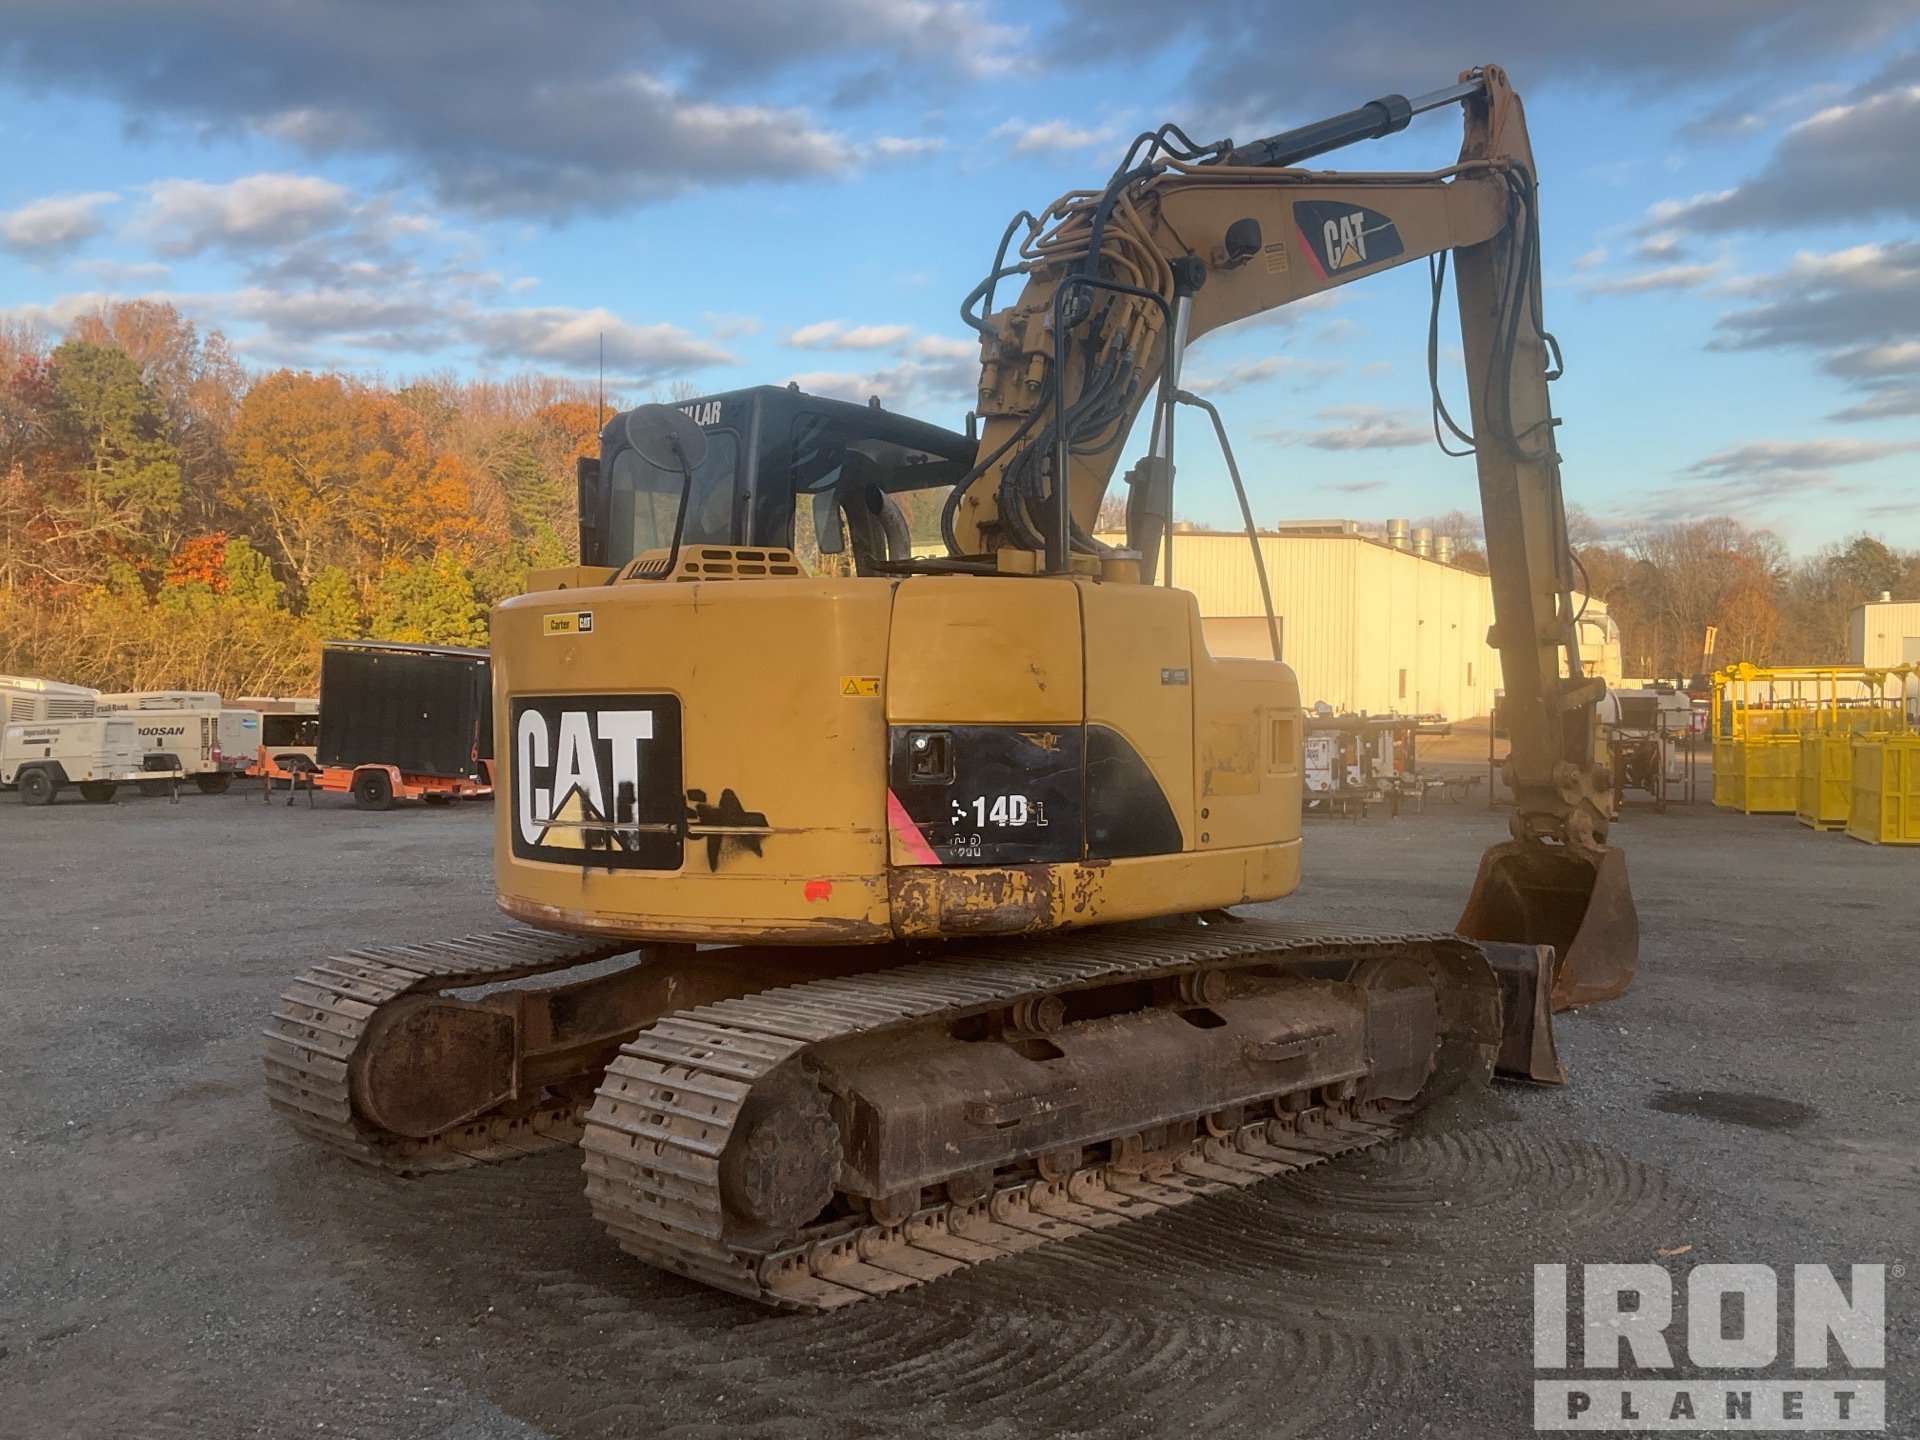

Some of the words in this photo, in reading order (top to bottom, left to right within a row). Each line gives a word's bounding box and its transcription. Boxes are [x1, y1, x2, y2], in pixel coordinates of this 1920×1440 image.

[1323, 211, 1367, 270] CAT
[551, 619, 570, 631] Carter
[579, 616, 592, 629] CAT
[517, 708, 654, 852] CAT
